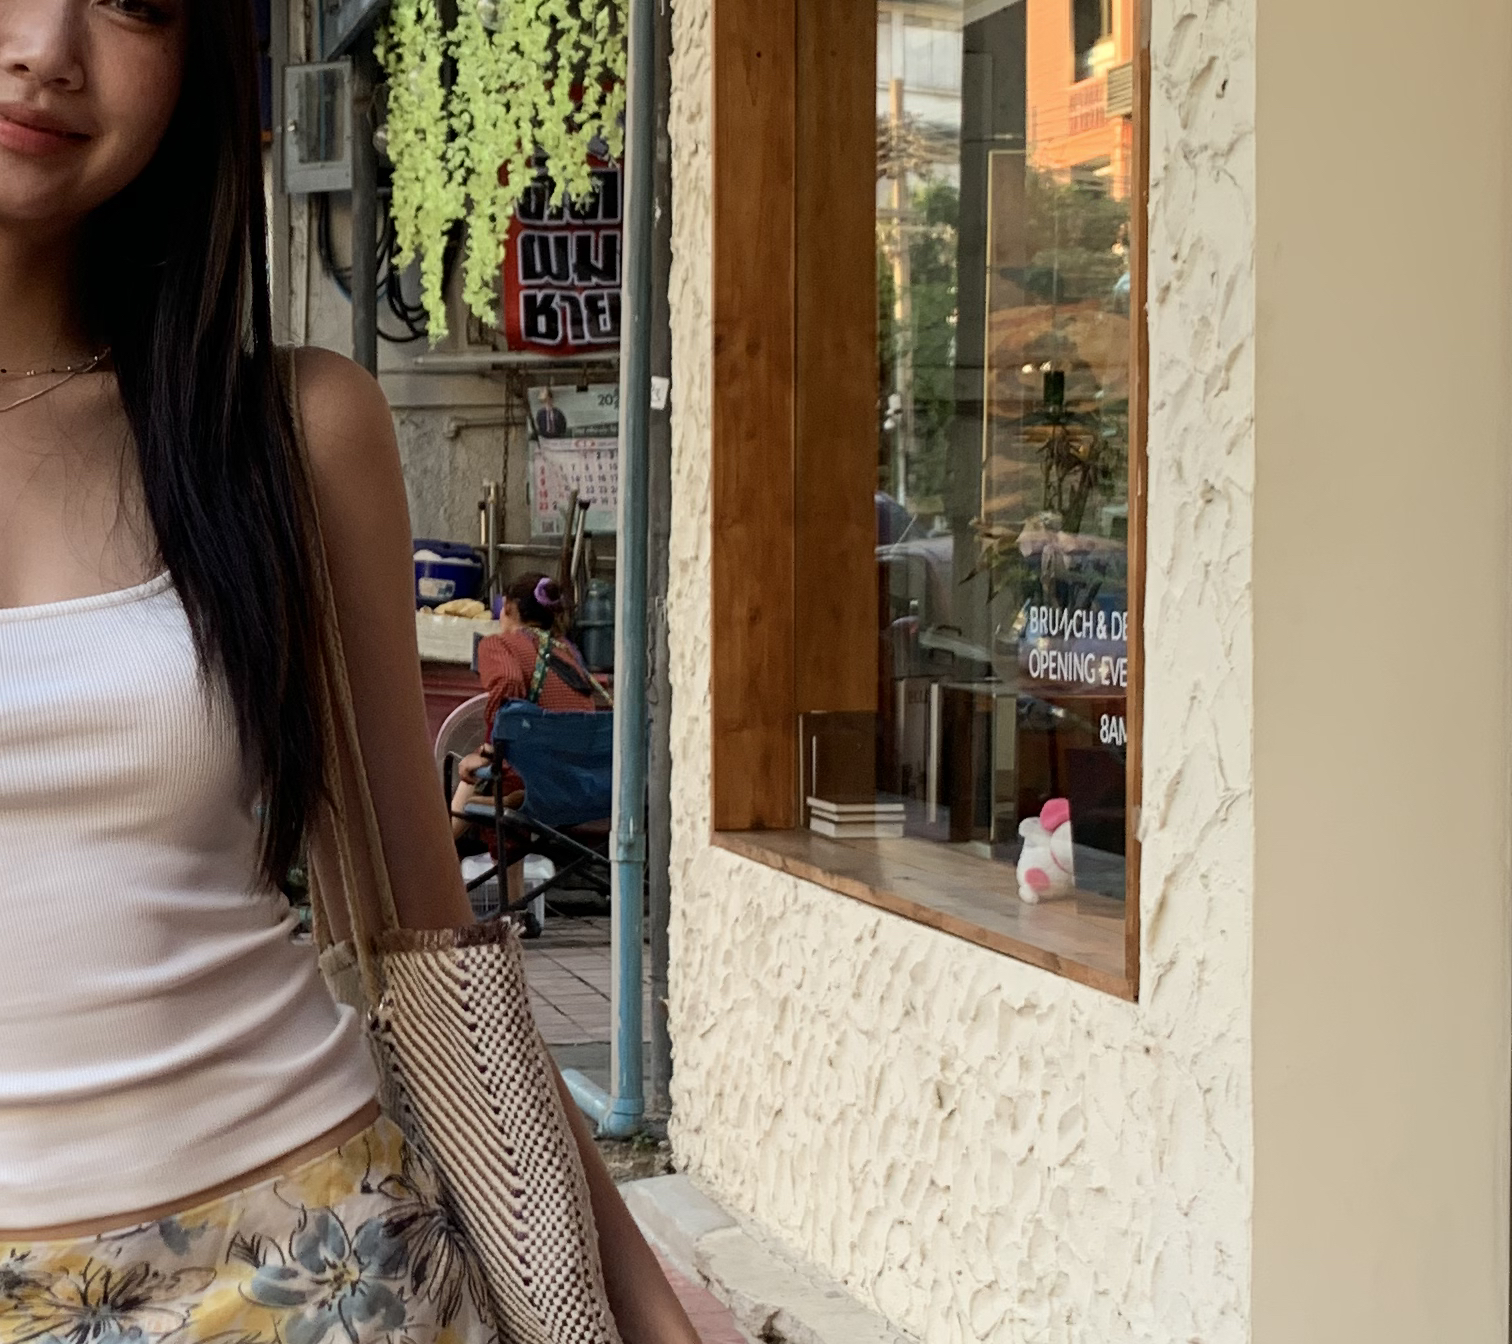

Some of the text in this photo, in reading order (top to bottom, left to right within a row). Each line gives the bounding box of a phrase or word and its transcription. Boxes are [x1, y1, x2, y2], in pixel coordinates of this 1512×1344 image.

[1029, 606, 1094, 642] BRUNCH
[1096, 610, 1108, 641] &
[1028, 649, 1096, 684] OPENING
